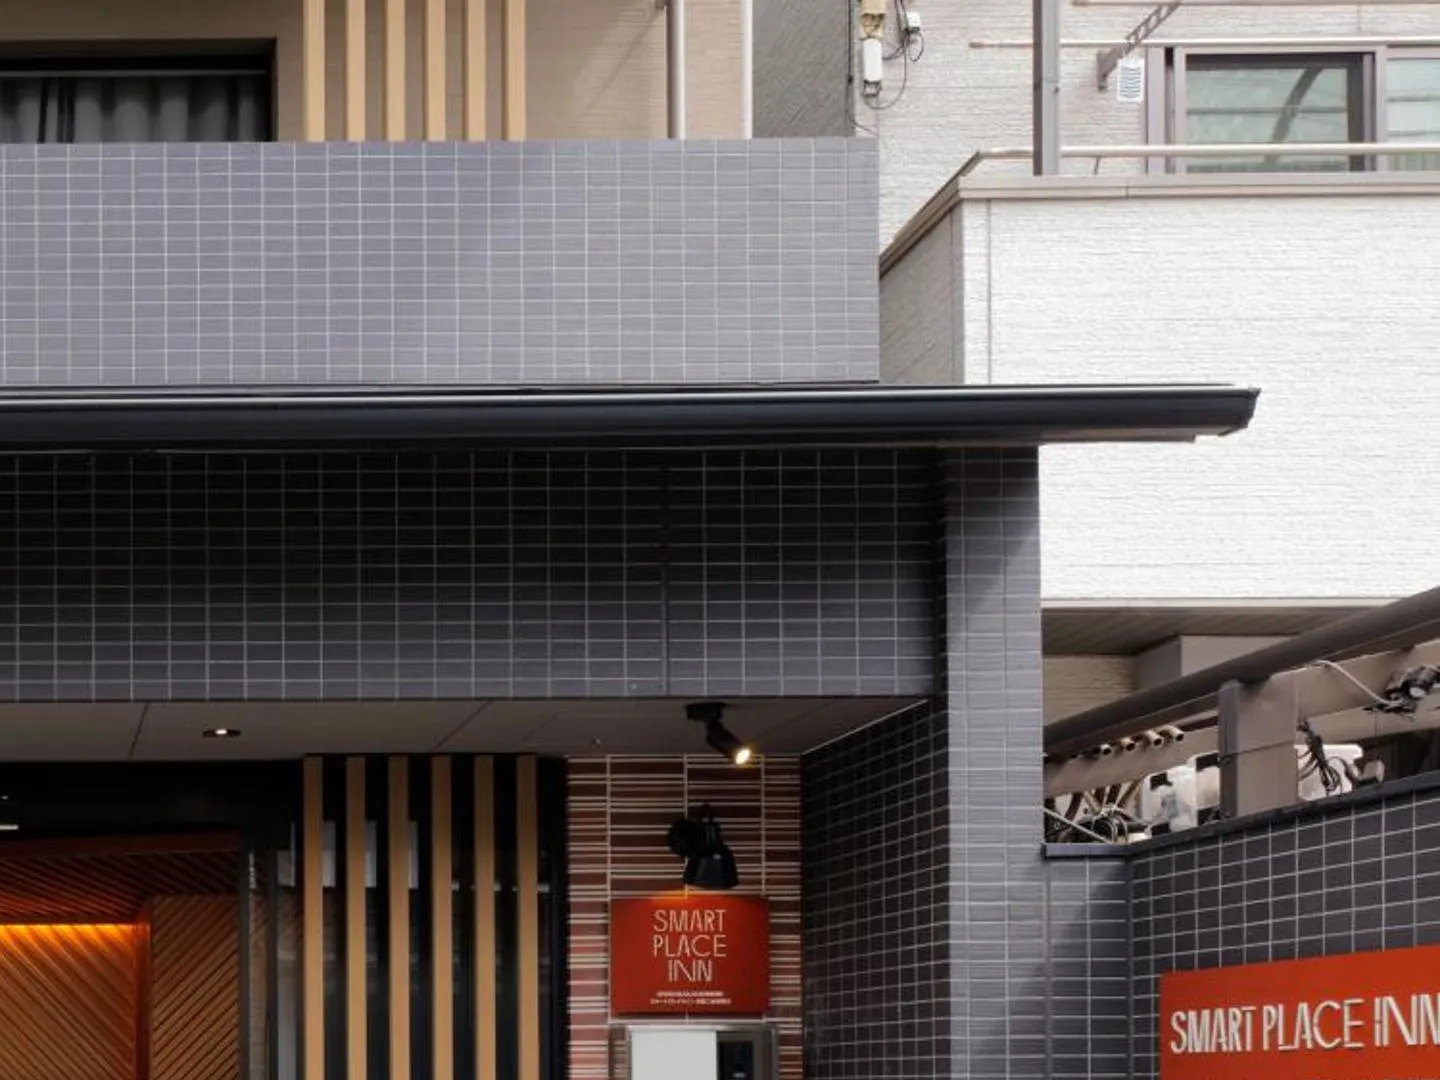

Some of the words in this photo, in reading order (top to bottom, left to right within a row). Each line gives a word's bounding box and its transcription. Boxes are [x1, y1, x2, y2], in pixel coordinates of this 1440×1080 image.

[653, 909, 727, 932] SMART
[653, 934, 727, 957] PLACE
[668, 959, 713, 982] INN
[1170, 1005, 1257, 1053] SMART
[1262, 998, 1365, 1051] PLACE
[1373, 992, 1440, 1047] INN
